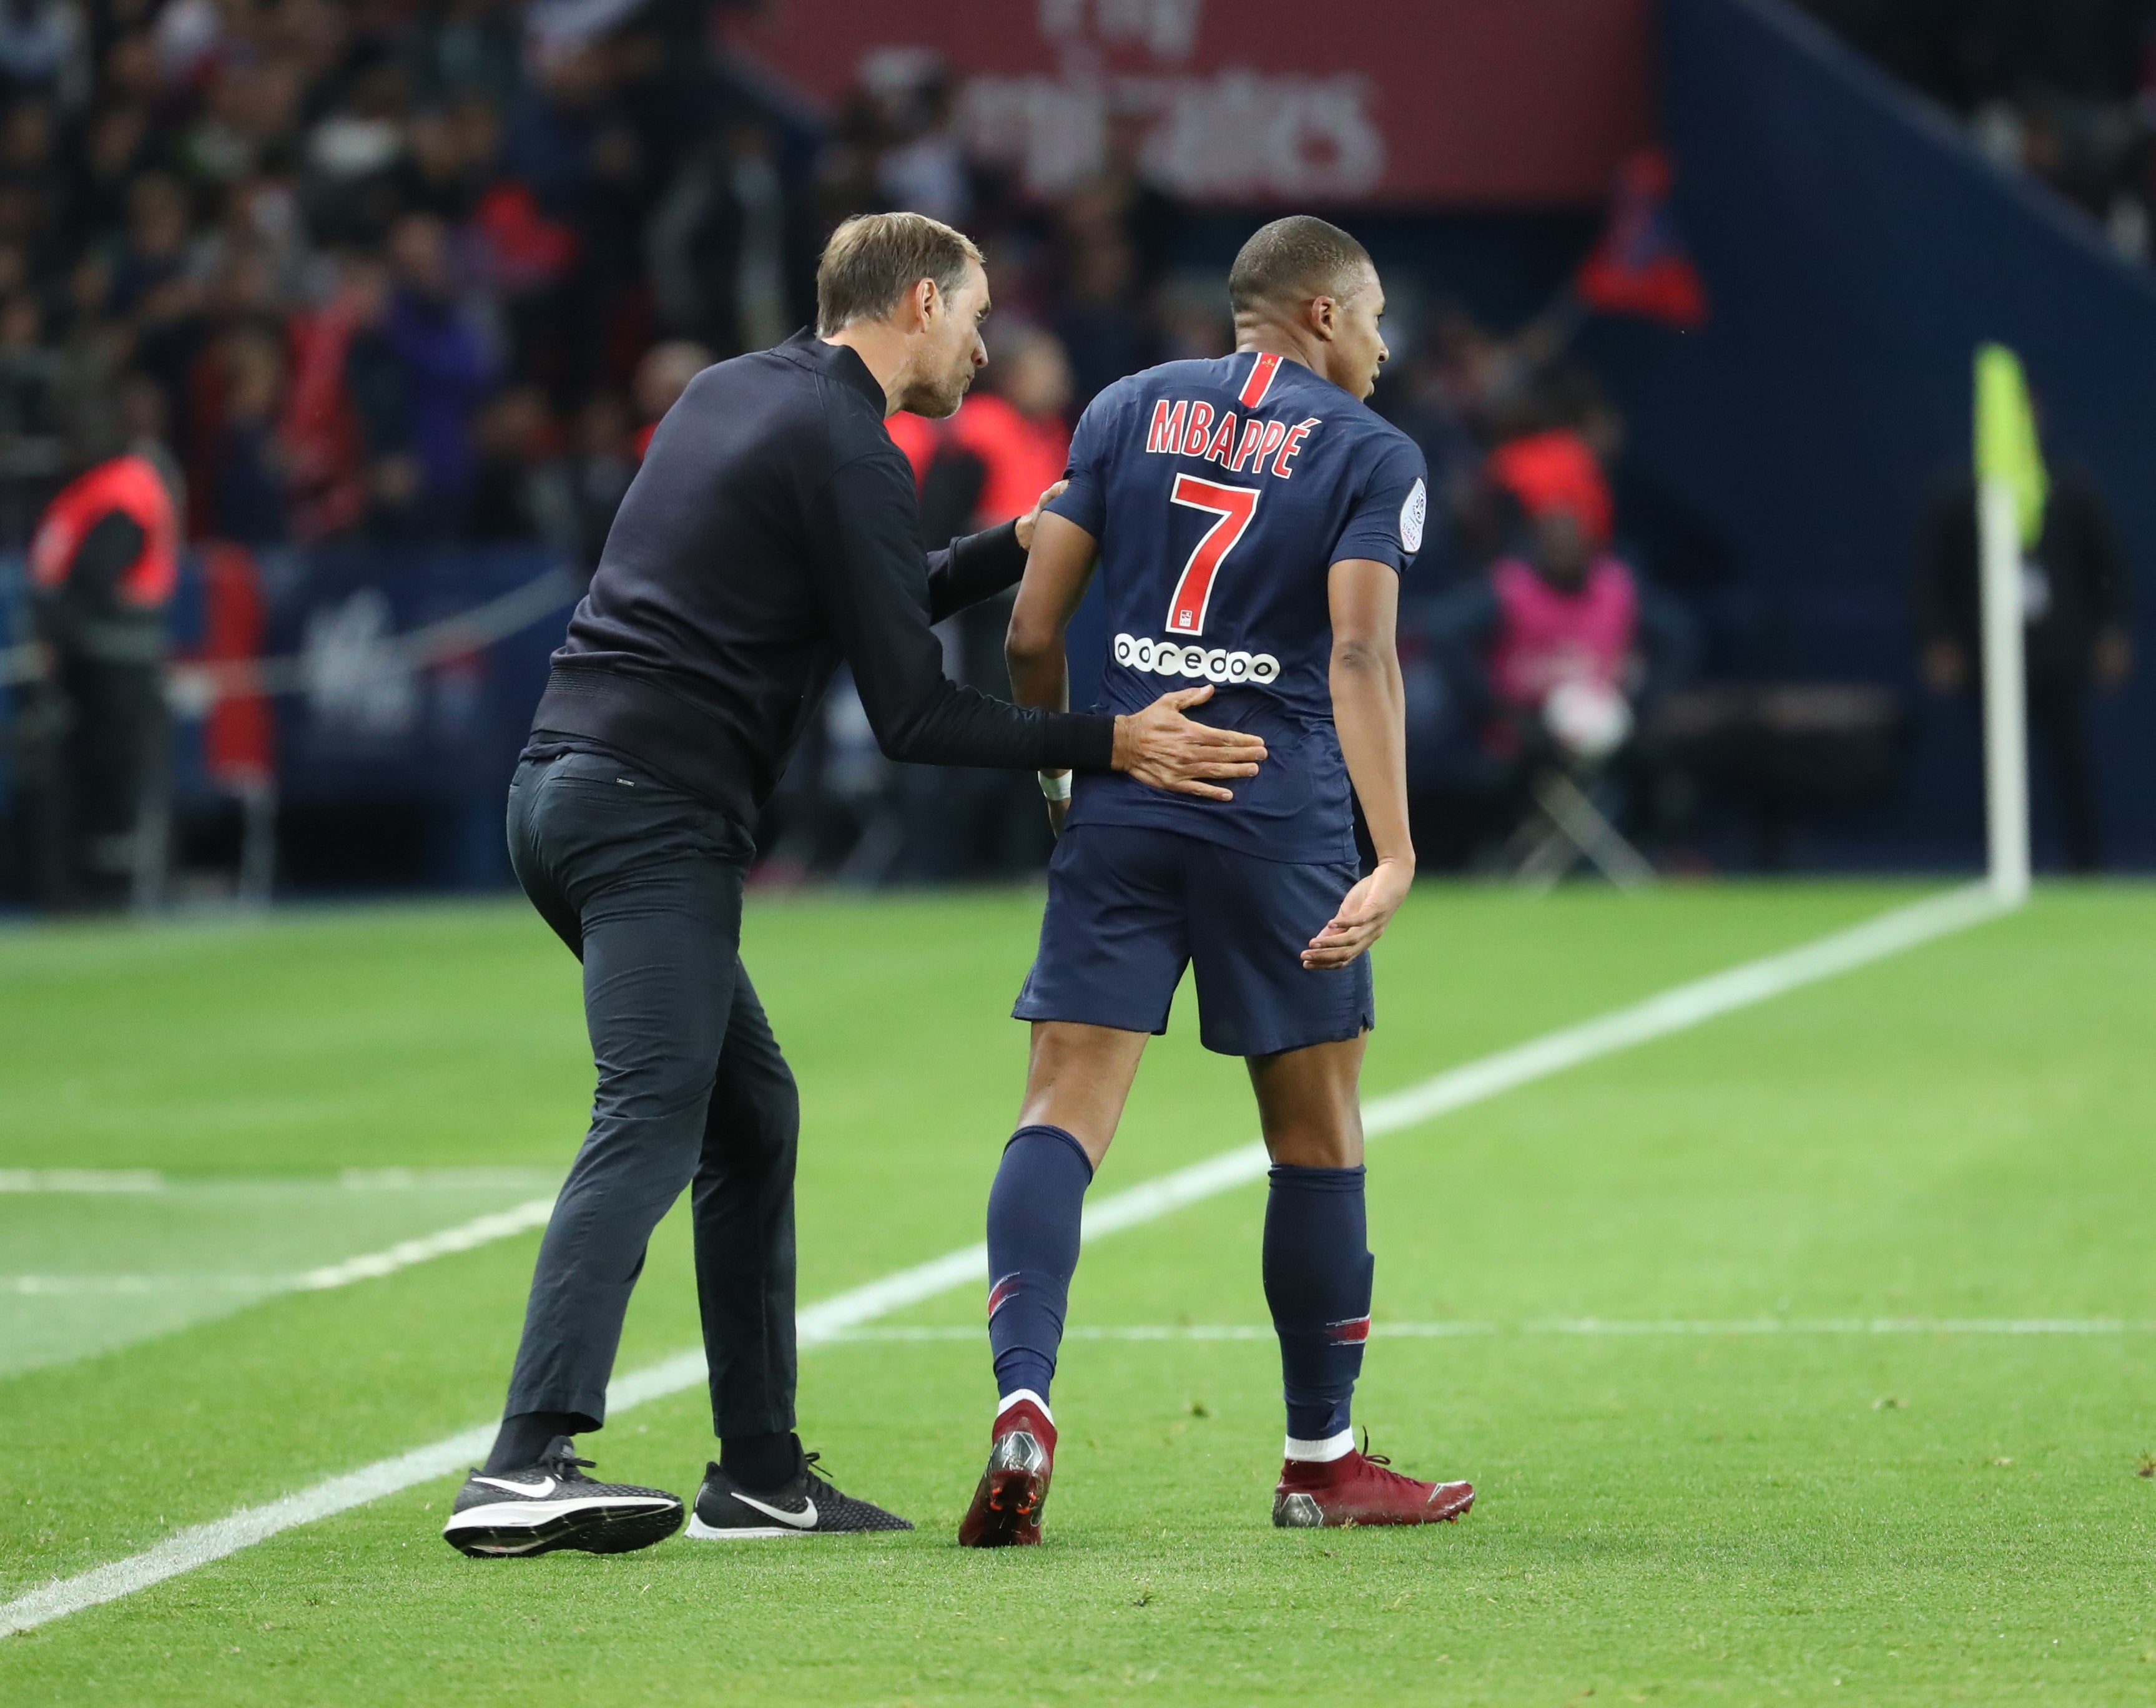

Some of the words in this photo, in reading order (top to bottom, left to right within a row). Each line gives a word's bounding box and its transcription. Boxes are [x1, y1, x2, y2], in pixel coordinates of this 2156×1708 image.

[1146, 399, 1322, 479] MBAPPÉ
[1165, 473, 1261, 636] 7
[1115, 636, 1277, 682] ooredoo
